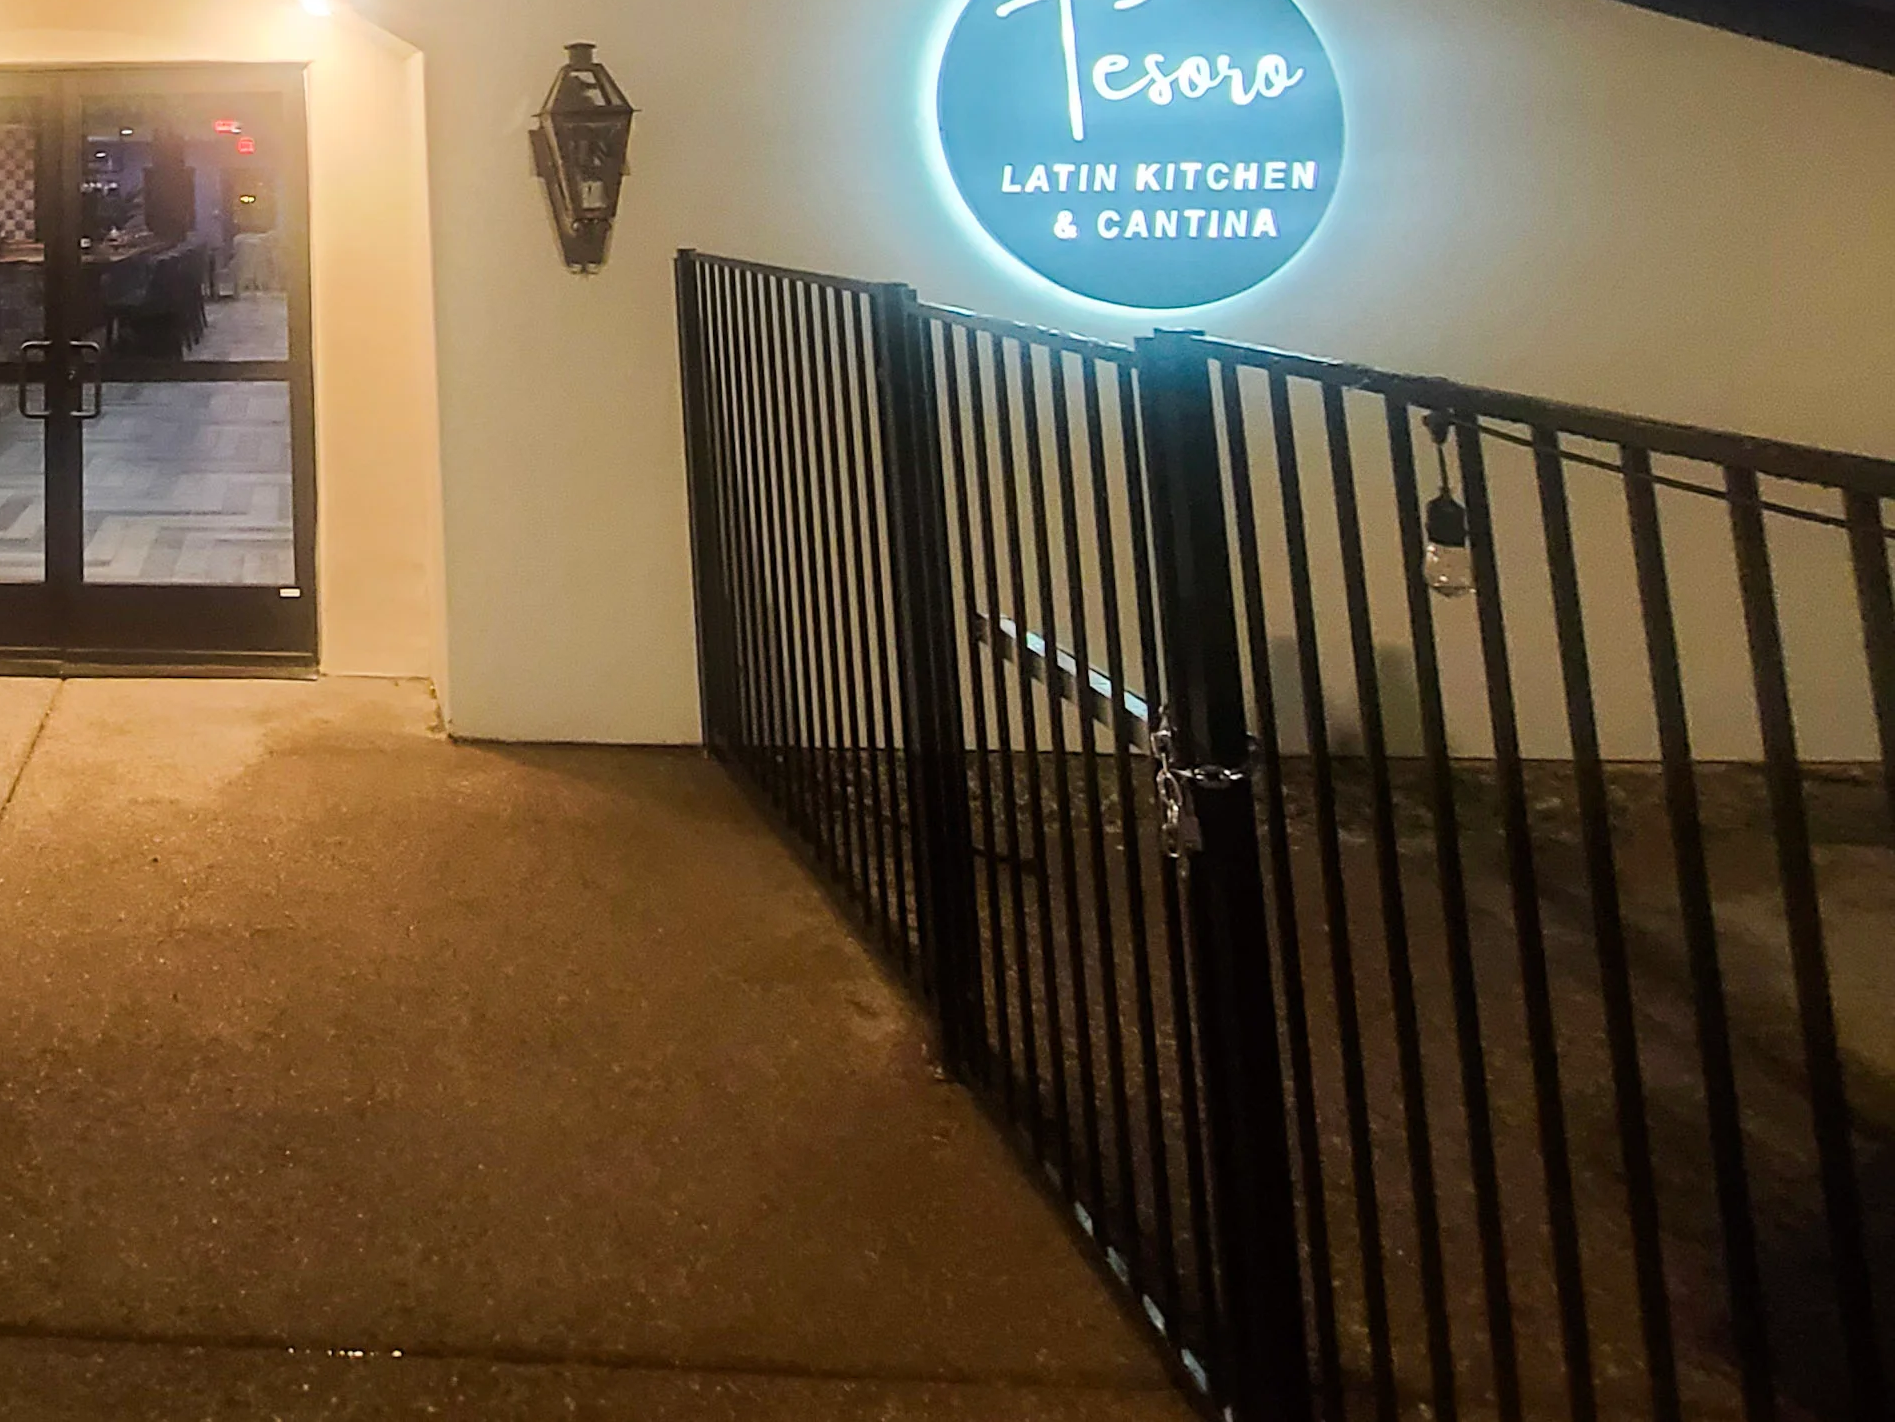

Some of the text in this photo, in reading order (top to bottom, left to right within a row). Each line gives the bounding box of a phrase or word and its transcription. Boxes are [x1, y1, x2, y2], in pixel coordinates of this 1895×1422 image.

[1001, 161, 1316, 193] LATIN KITCHEN
[1053, 208, 1278, 239] & CANTINA
